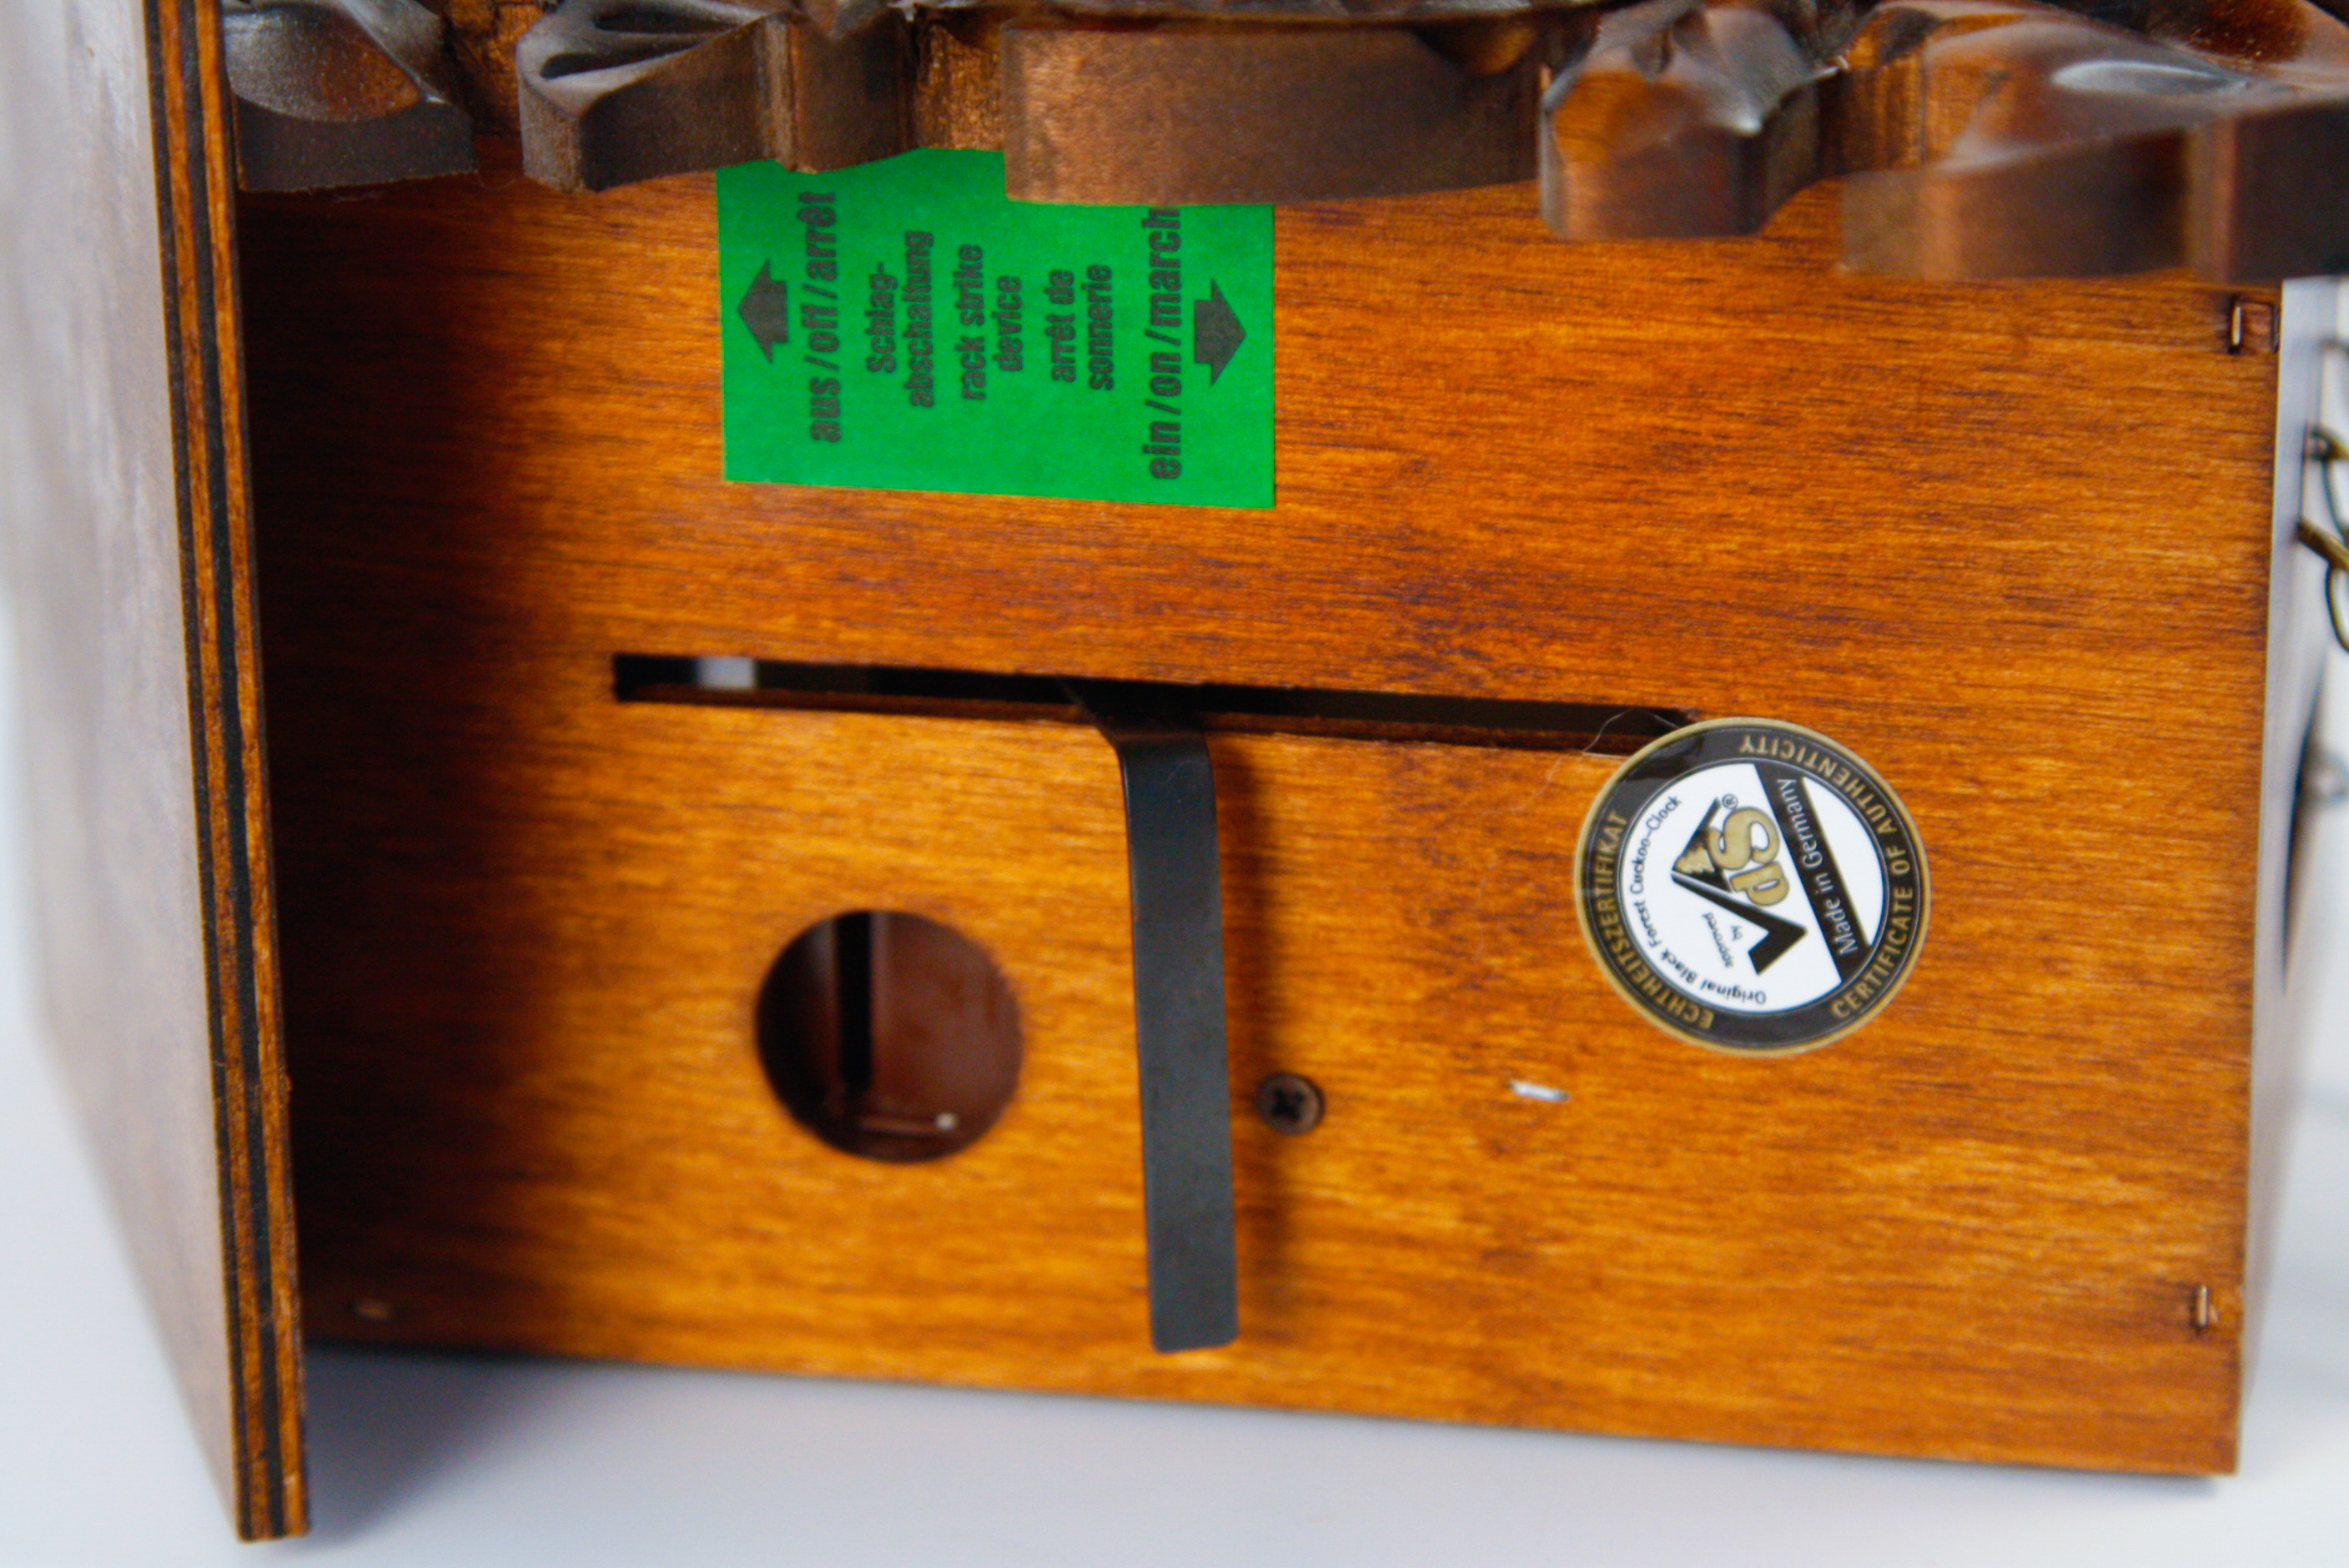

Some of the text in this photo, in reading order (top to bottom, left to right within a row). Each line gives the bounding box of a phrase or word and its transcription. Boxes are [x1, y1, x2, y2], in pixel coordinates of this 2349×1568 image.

[866, 262, 898, 373] Schlag-
[903, 231, 934, 407] abschaltung
[1142, 205, 1181, 327] march
[953, 245, 986, 400] rack strike
[992, 276, 1023, 371] device
[1044, 270, 1076, 382] arrêt de
[1081, 265, 1114, 390] sonnerie
[1594, 810, 1715, 1029] ECHTHEITSZERTIFIKAT
[1632, 897, 1662, 949] Forest
[1739, 735, 1914, 1019] CERTIFICATE OF AUTHENTICITY
[1777, 777, 1859, 957] Made in Germany
[1660, 947, 1698, 984] Black
[1702, 912, 1734, 968] approved
[1729, 924, 1743, 942] by
[1700, 978, 1767, 1005] Original
